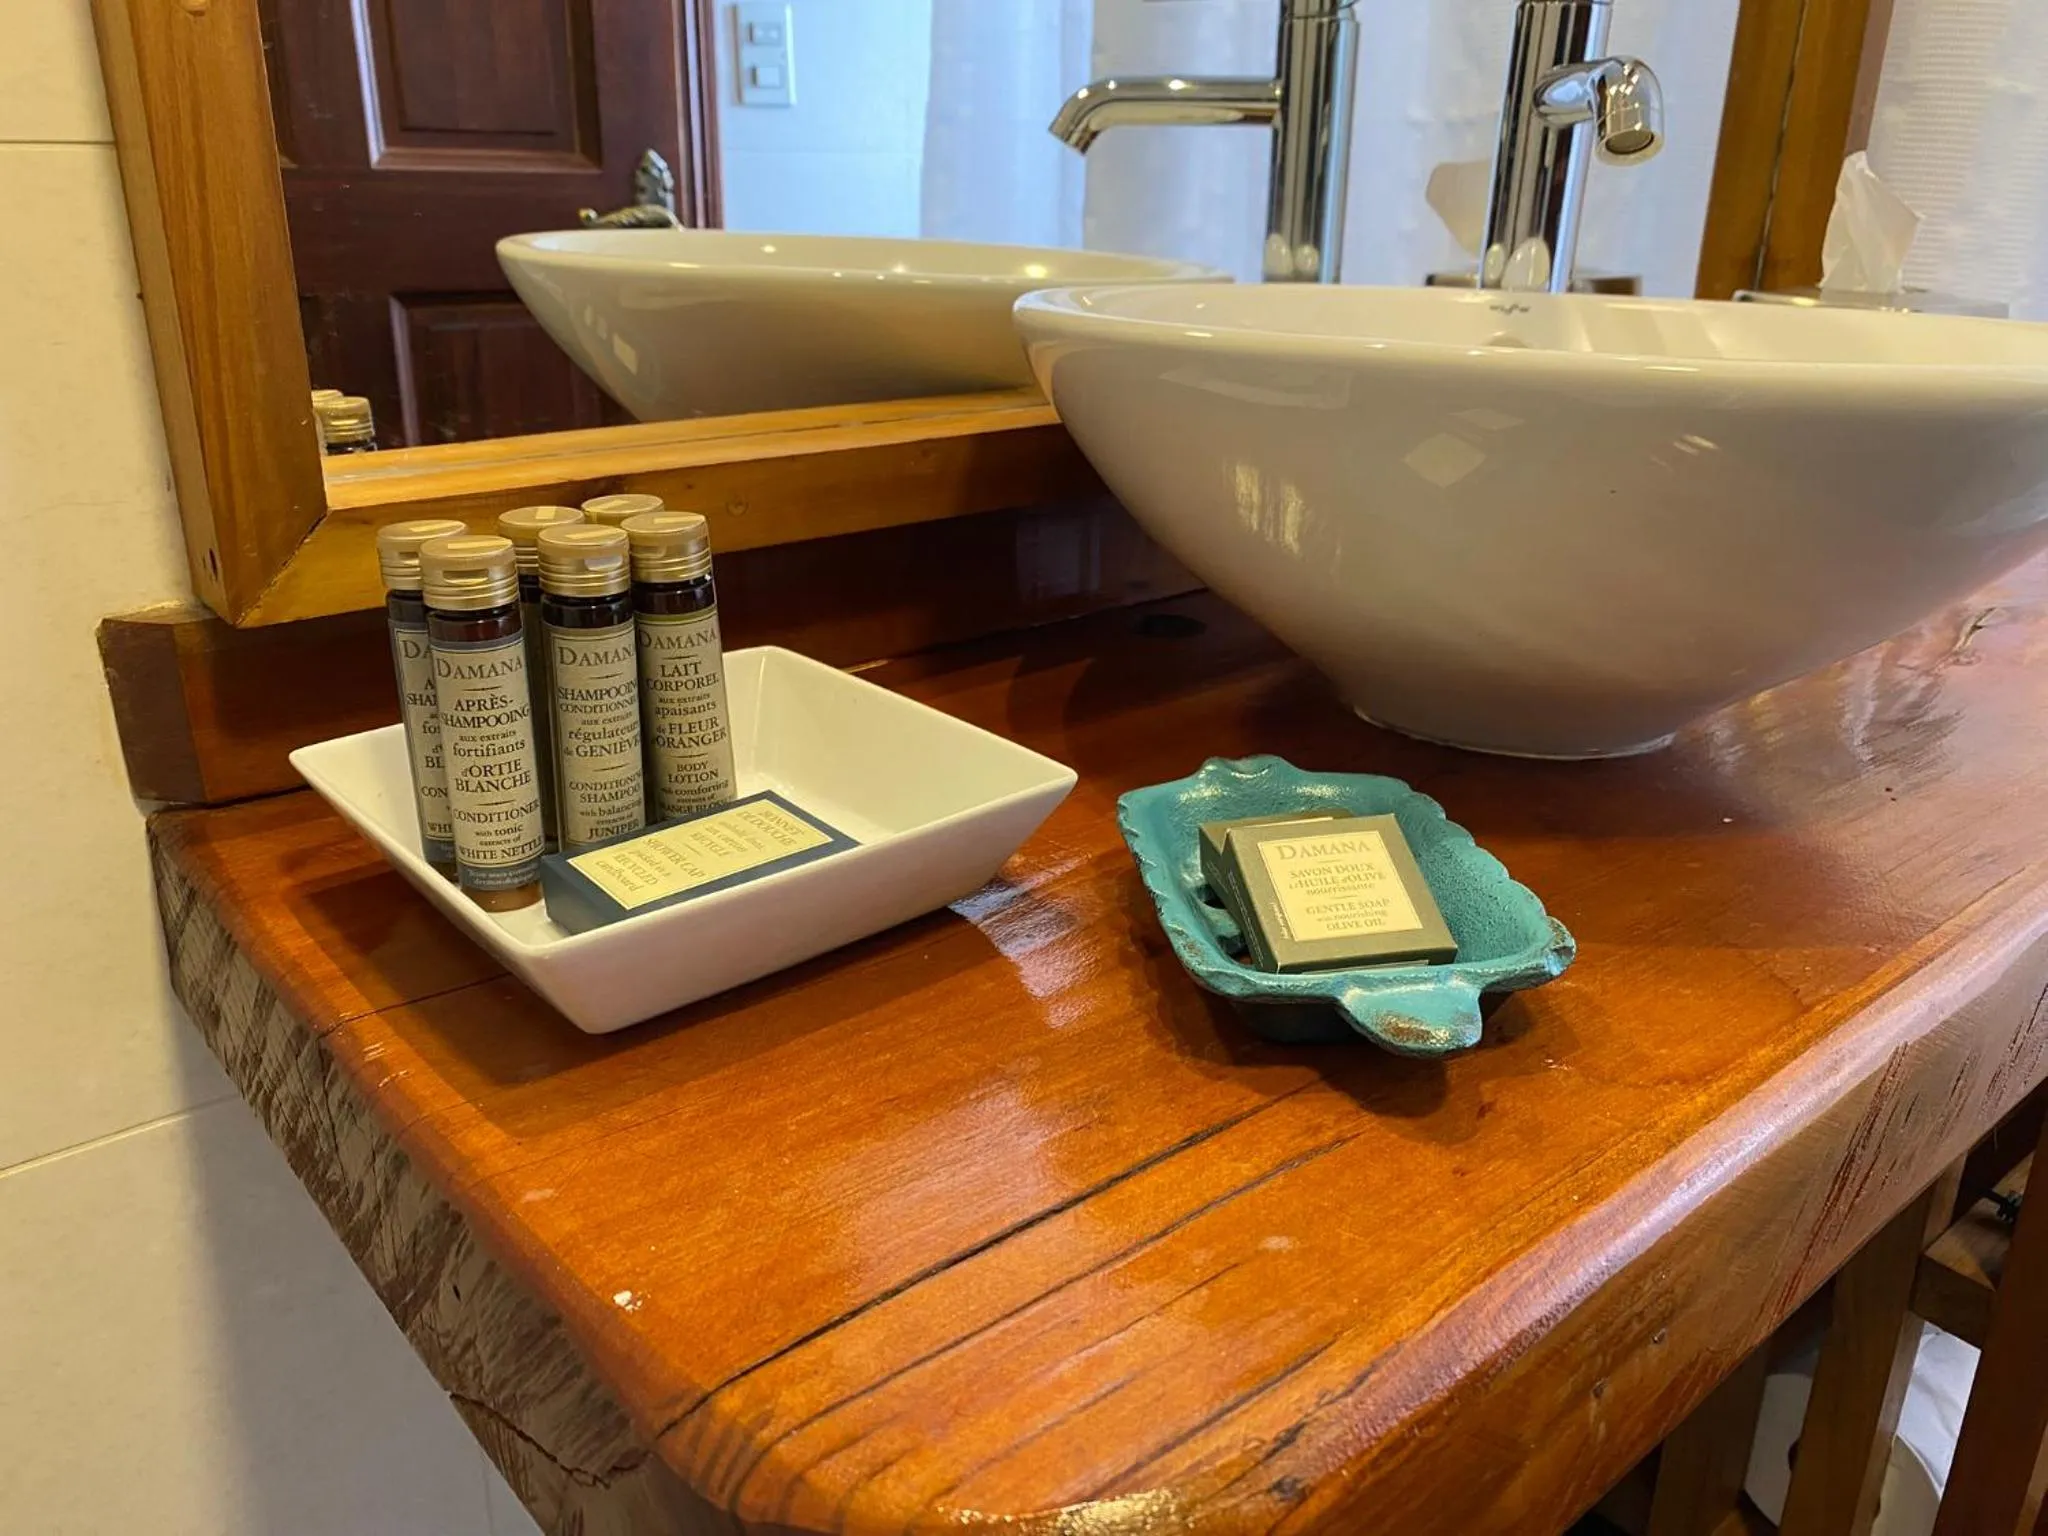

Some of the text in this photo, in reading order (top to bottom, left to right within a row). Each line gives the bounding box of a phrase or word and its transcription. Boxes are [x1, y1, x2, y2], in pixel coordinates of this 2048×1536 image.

[638, 628, 717, 650] DAMANA
[558, 645, 634, 667] DAMAN
[436, 656, 522, 680] DAMANA
[661, 660, 702, 677] LAIT
[558, 680, 637, 701] SHAMPOOIN
[646, 672, 719, 691] CORPOREL
[454, 693, 514, 712] APRÈS-
[560, 695, 635, 714] CONDITIONN
[655, 702, 716, 719] apaisants
[441, 703, 530, 729] SHAMPOOING
[668, 716, 719, 735] FLEUR
[480, 729, 517, 742] extraits
[568, 720, 638, 743] régulateur
[453, 739, 525, 757] fortifiants
[576, 732, 639, 757] GENIÈVR
[667, 768, 719, 784] LOTION
[676, 760, 708, 773] BODY
[455, 770, 532, 793] BLANCHE
[569, 769, 641, 791] CONDITIONIN
[453, 800, 540, 824] CONDITIONER
[427, 822, 452, 833] WHI
[494, 824, 524, 836] tonic
[587, 818, 640, 840] JUNIPER
[459, 846, 498, 859] WHITE
[1273, 841, 1371, 860] DAMANA
[680, 862, 706, 877] CAP
[1290, 863, 1375, 879] SAVON DOUX
[1306, 898, 1390, 915] GENTLE SOAP
[1326, 917, 1386, 931] OLIVE OIL
